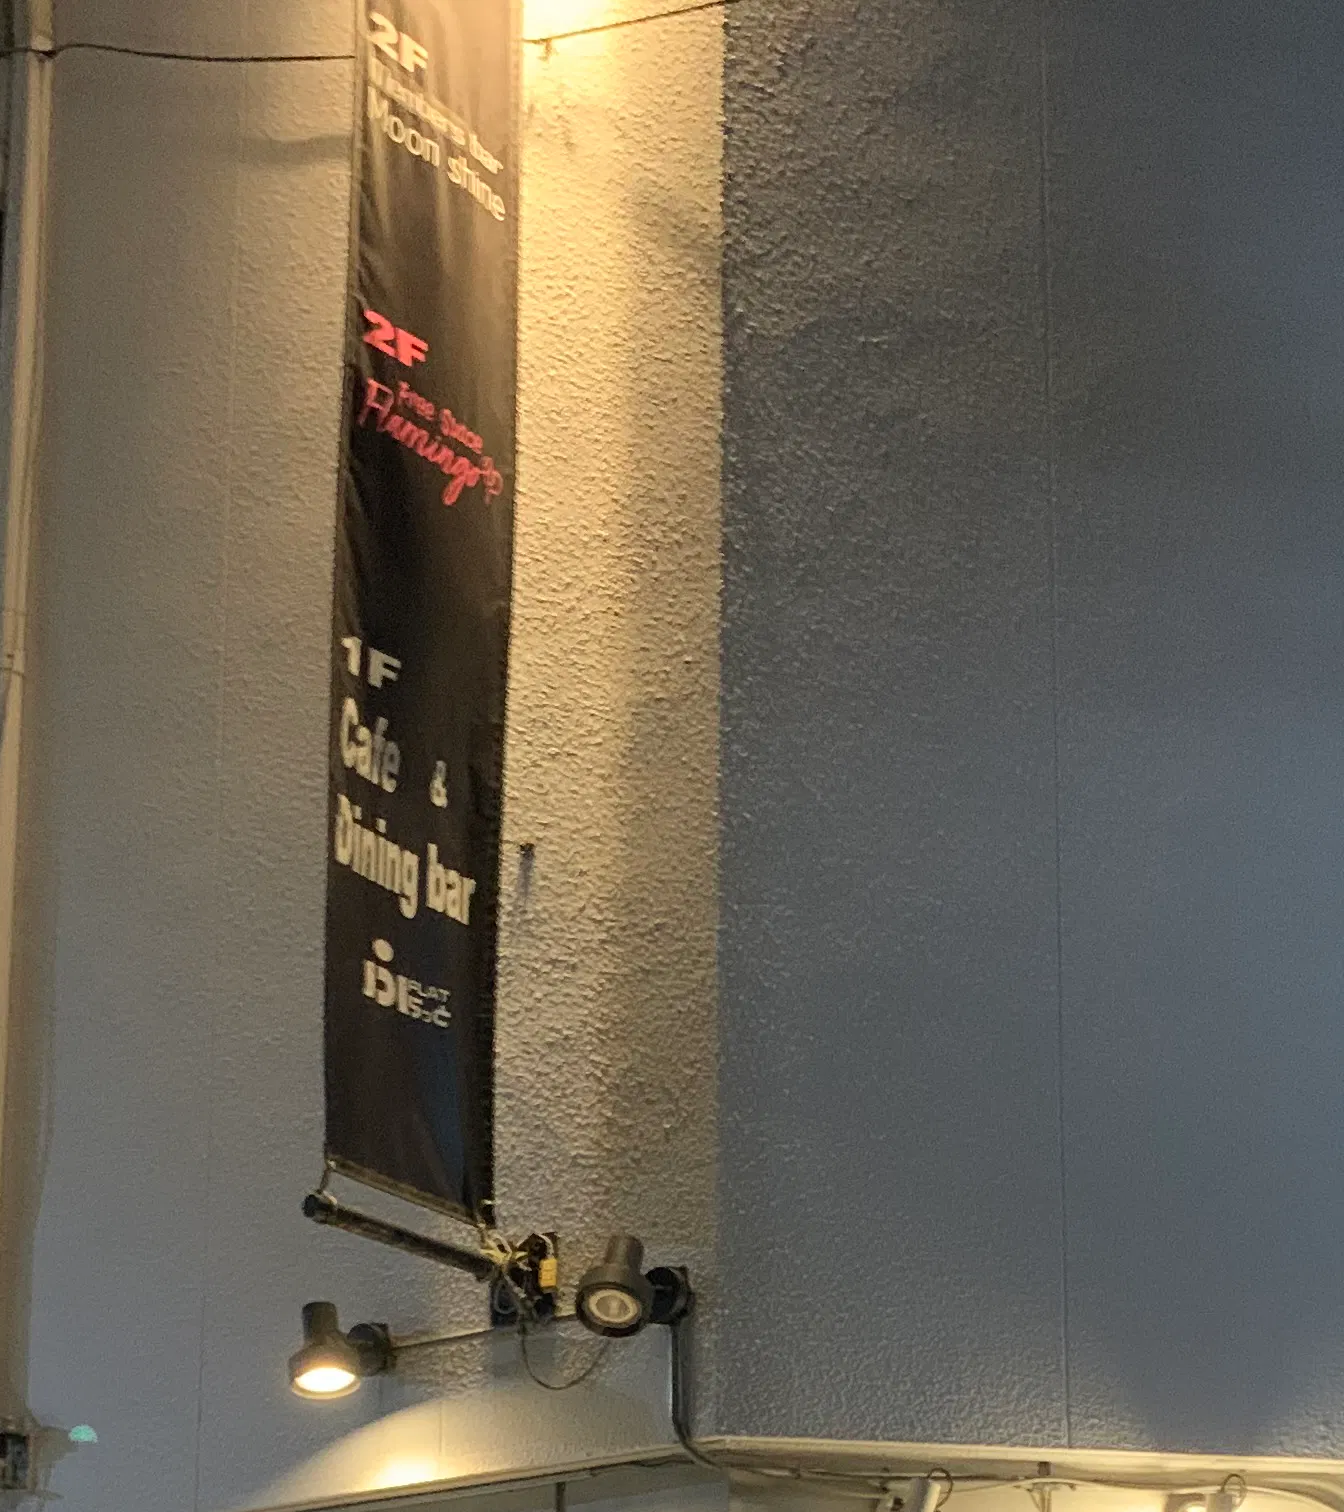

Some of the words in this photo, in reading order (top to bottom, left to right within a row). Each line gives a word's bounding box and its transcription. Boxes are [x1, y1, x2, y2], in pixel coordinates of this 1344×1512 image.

[371, 11, 428, 73] 2F
[368, 86, 439, 166] Moon
[447, 156, 506, 222] shine
[469, 133, 504, 175] bar
[363, 309, 428, 367] 2F
[357, 377, 481, 506] Flamingo
[340, 635, 402, 688] 1F
[340, 698, 401, 793] Cafe
[334, 793, 419, 919] Dining
[426, 843, 476, 925] bar
